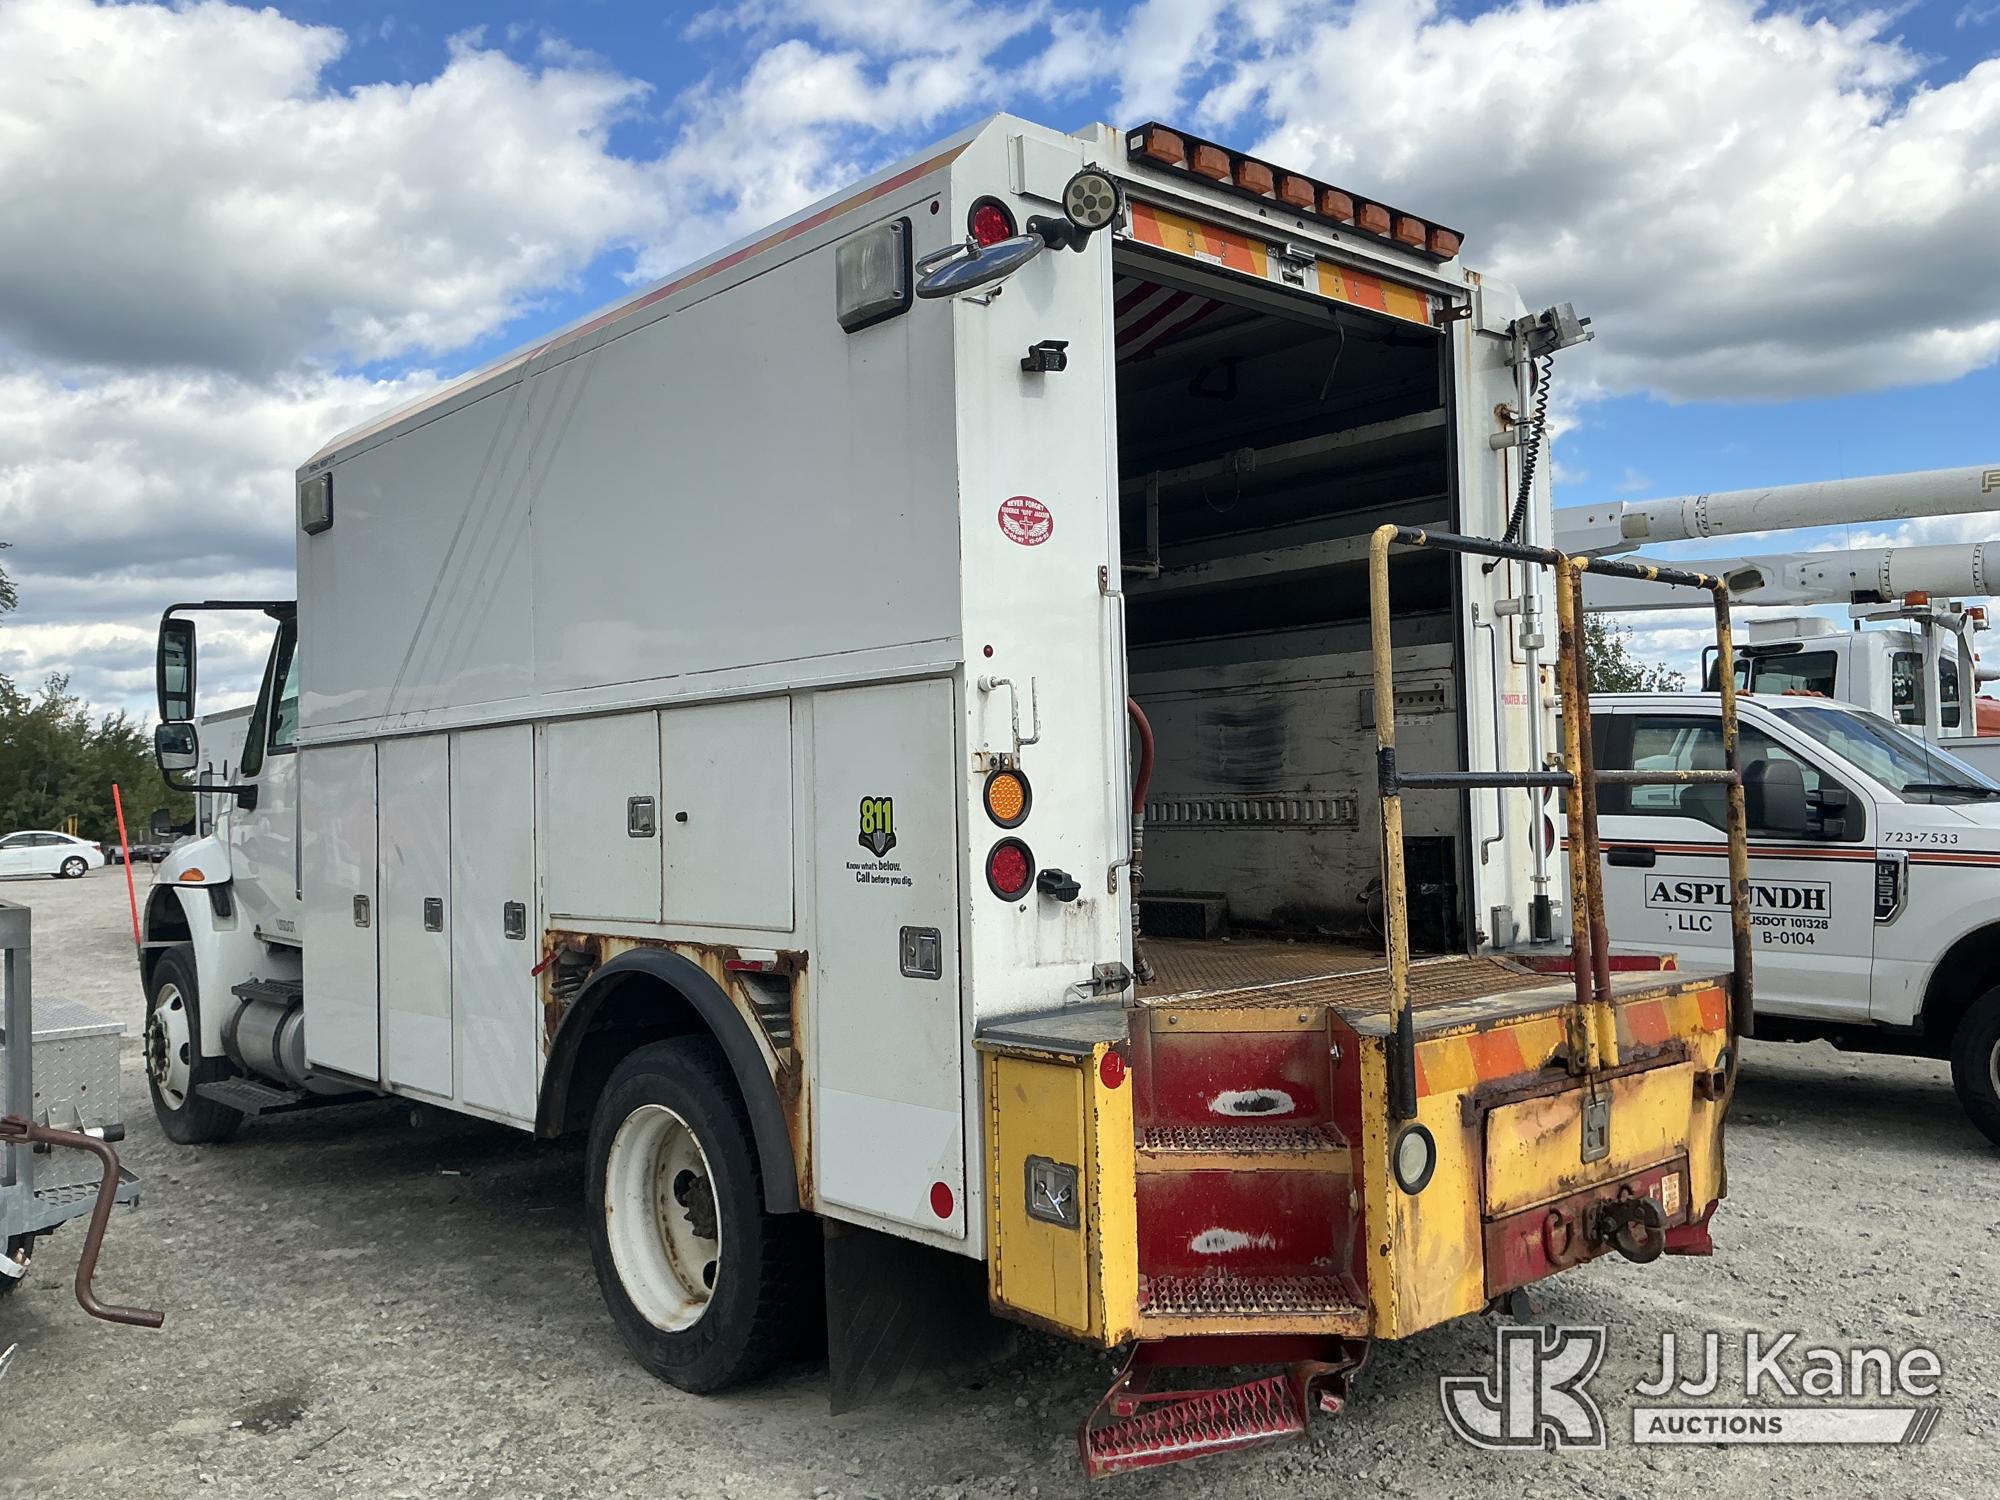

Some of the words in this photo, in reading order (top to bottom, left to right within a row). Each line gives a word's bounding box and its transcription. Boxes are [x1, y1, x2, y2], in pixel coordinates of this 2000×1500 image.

[861, 798, 892, 834] 811
[1885, 832, 1958, 844] 723-7533
[846, 861, 860, 870] Know
[861, 862, 878, 870] what's
[878, 860, 901, 871] below.
[856, 871, 870, 883] Call
[871, 874, 890, 884] before
[890, 877, 901, 886] you
[901, 875, 913, 887] dig.
[1650, 881, 1826, 911] ASPLNDH
[1678, 914, 1712, 932] LLC
[1790, 918, 1829, 930] 101328
[1763, 931, 1815, 945] B-0104
